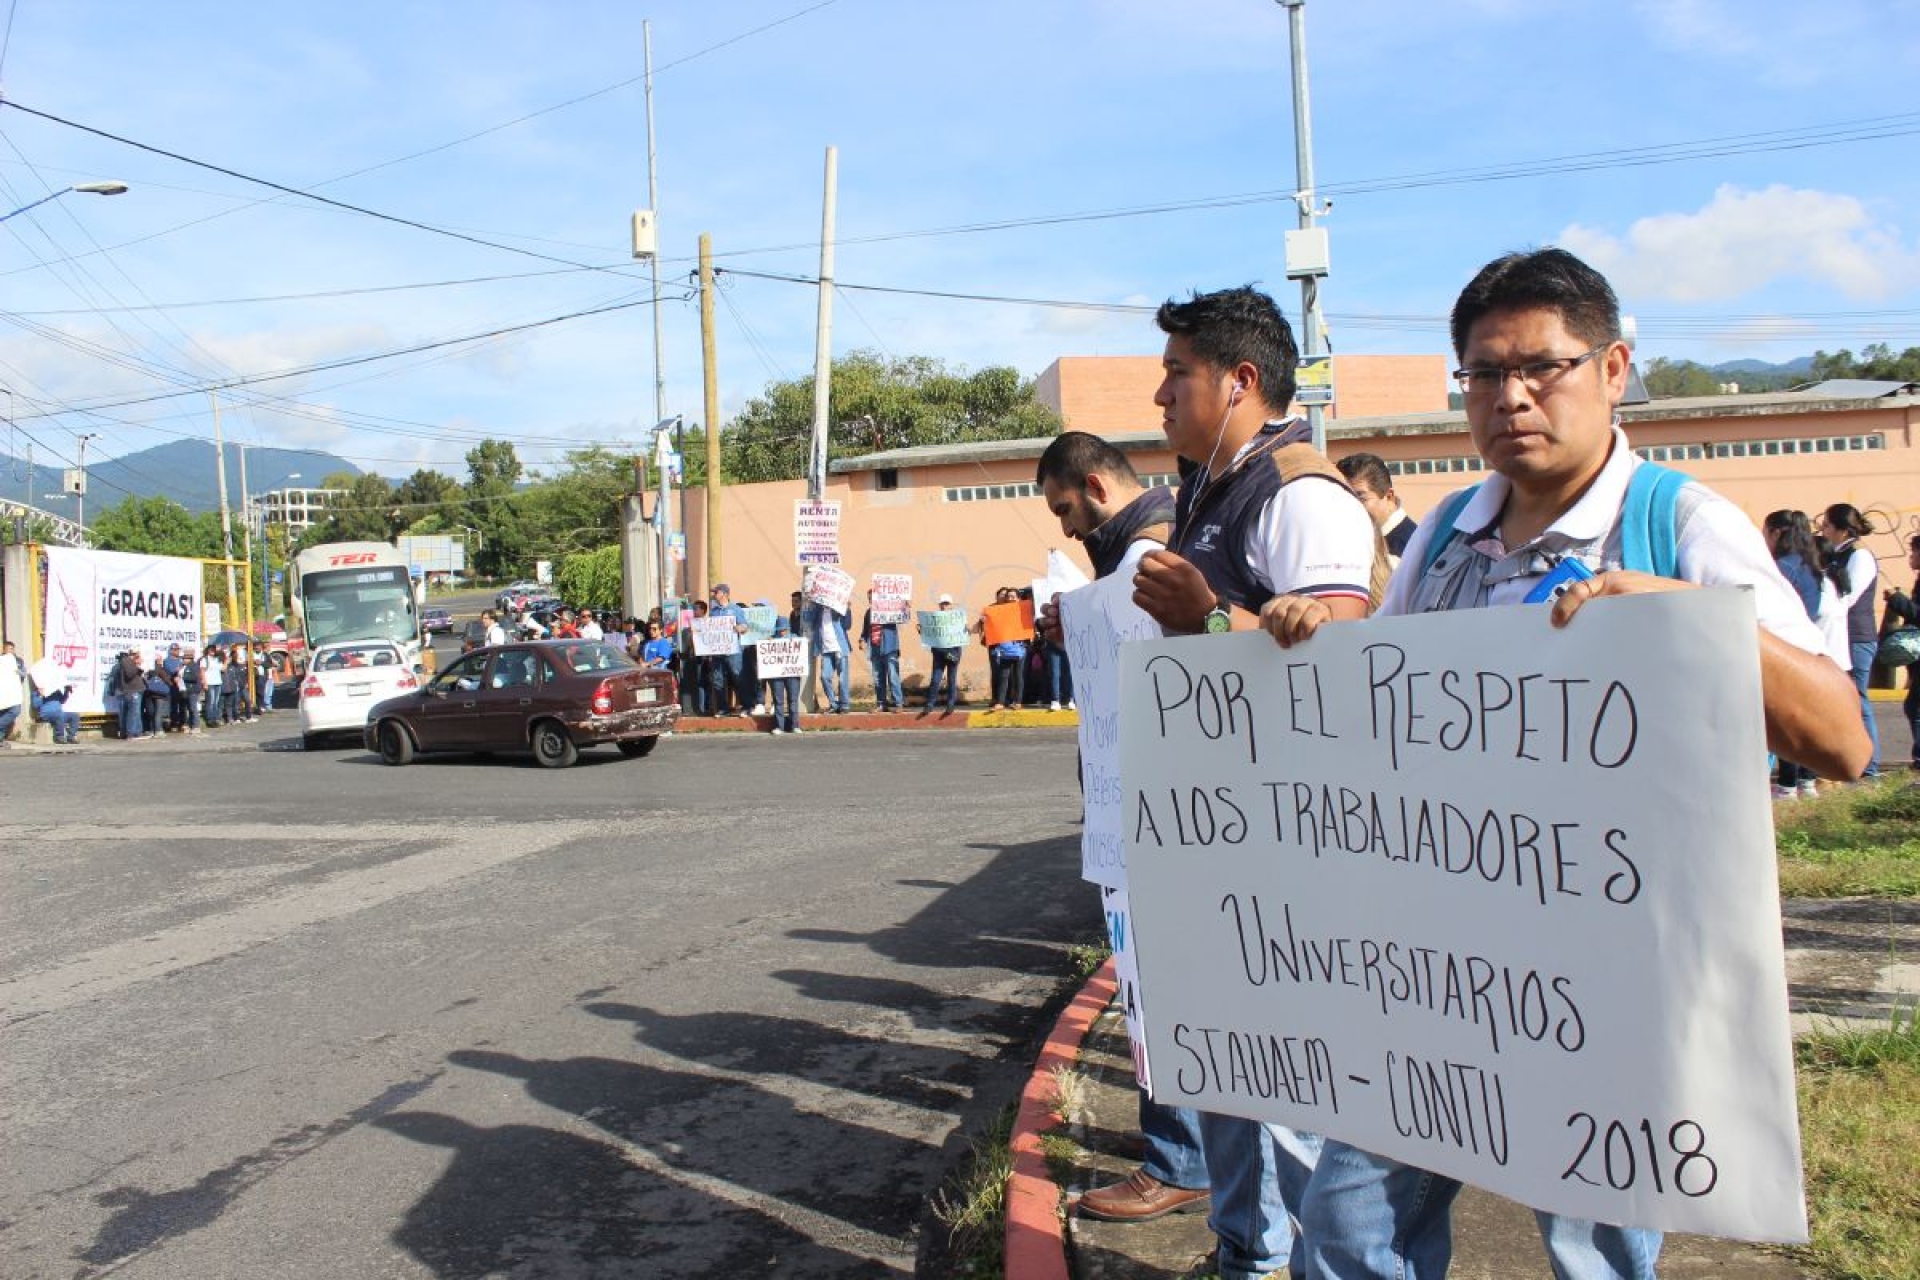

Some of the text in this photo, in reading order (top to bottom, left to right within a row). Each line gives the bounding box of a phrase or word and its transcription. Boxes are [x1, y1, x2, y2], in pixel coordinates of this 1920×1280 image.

[101, 587, 194, 620] ¡GRACIAS!
[328, 553, 378, 566] TER
[107, 627, 132, 639] TODOS
[134, 629, 148, 639] LOS
[1145, 643, 1639, 770] POR EL RESPETO
[1135, 781, 1641, 905] A LOS TRABAJADORES
[1221, 893, 1586, 1053] UNIVERSITARIOS
[1386, 1050, 1507, 1166] CONTU
[1561, 1112, 1718, 1197] 2018
